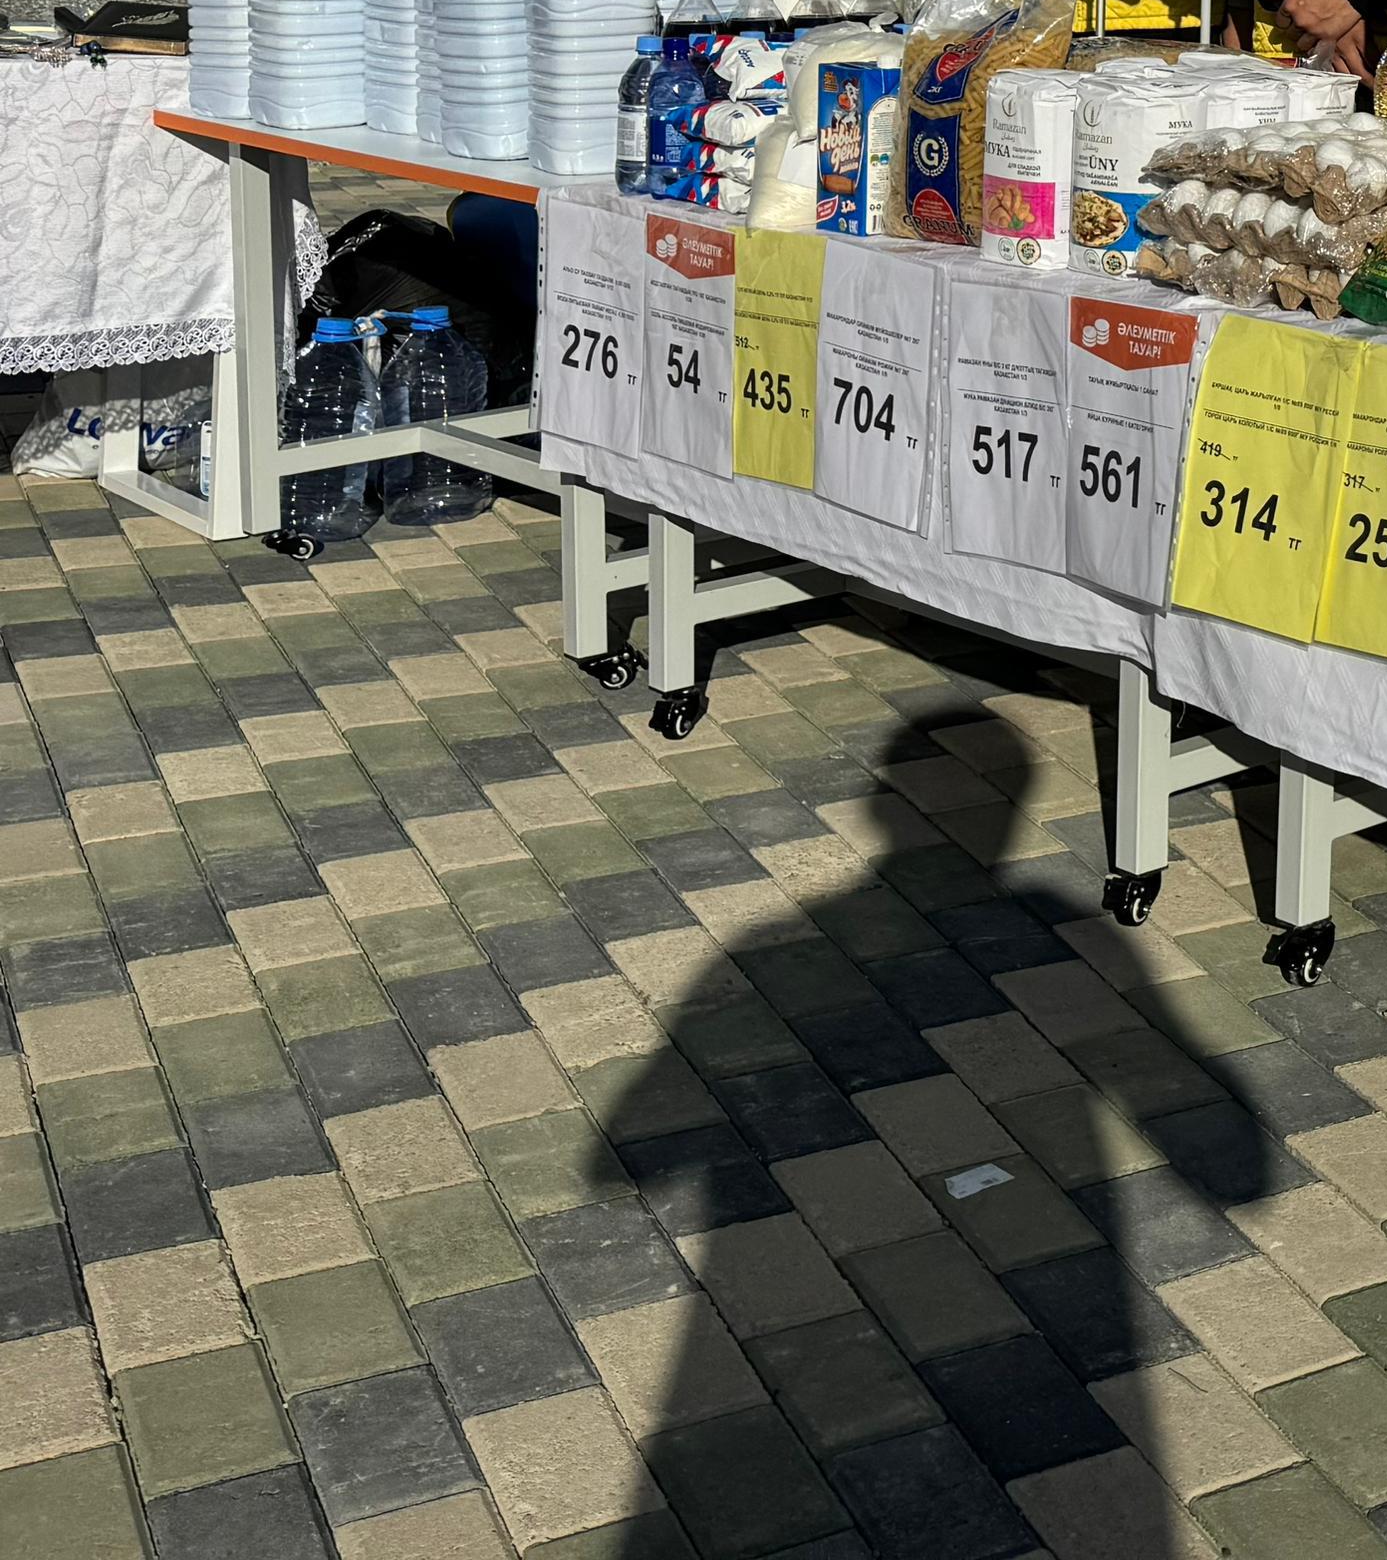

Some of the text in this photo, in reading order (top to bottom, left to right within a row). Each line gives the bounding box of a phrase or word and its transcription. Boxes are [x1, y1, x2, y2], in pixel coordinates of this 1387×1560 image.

[993, 118, 1027, 134] Ramazan
[1075, 128, 1113, 144] Ramazan
[920, 139, 940, 167] G
[985, 141, 1010, 158] МУКА
[902, 215, 975, 236] GRANUM
[561, 324, 618, 379] 276
[1118, 323, 1176, 344] ӘЛЕУМЕТТІК
[1129, 341, 1161, 359] ТАУАР!
[667, 343, 701, 395] 54
[743, 368, 792, 414] 435
[833, 377, 895, 441] 704
[972, 426, 1038, 482] 517
[1080, 445, 1141, 508] 561
[1200, 479, 1279, 541] 314
